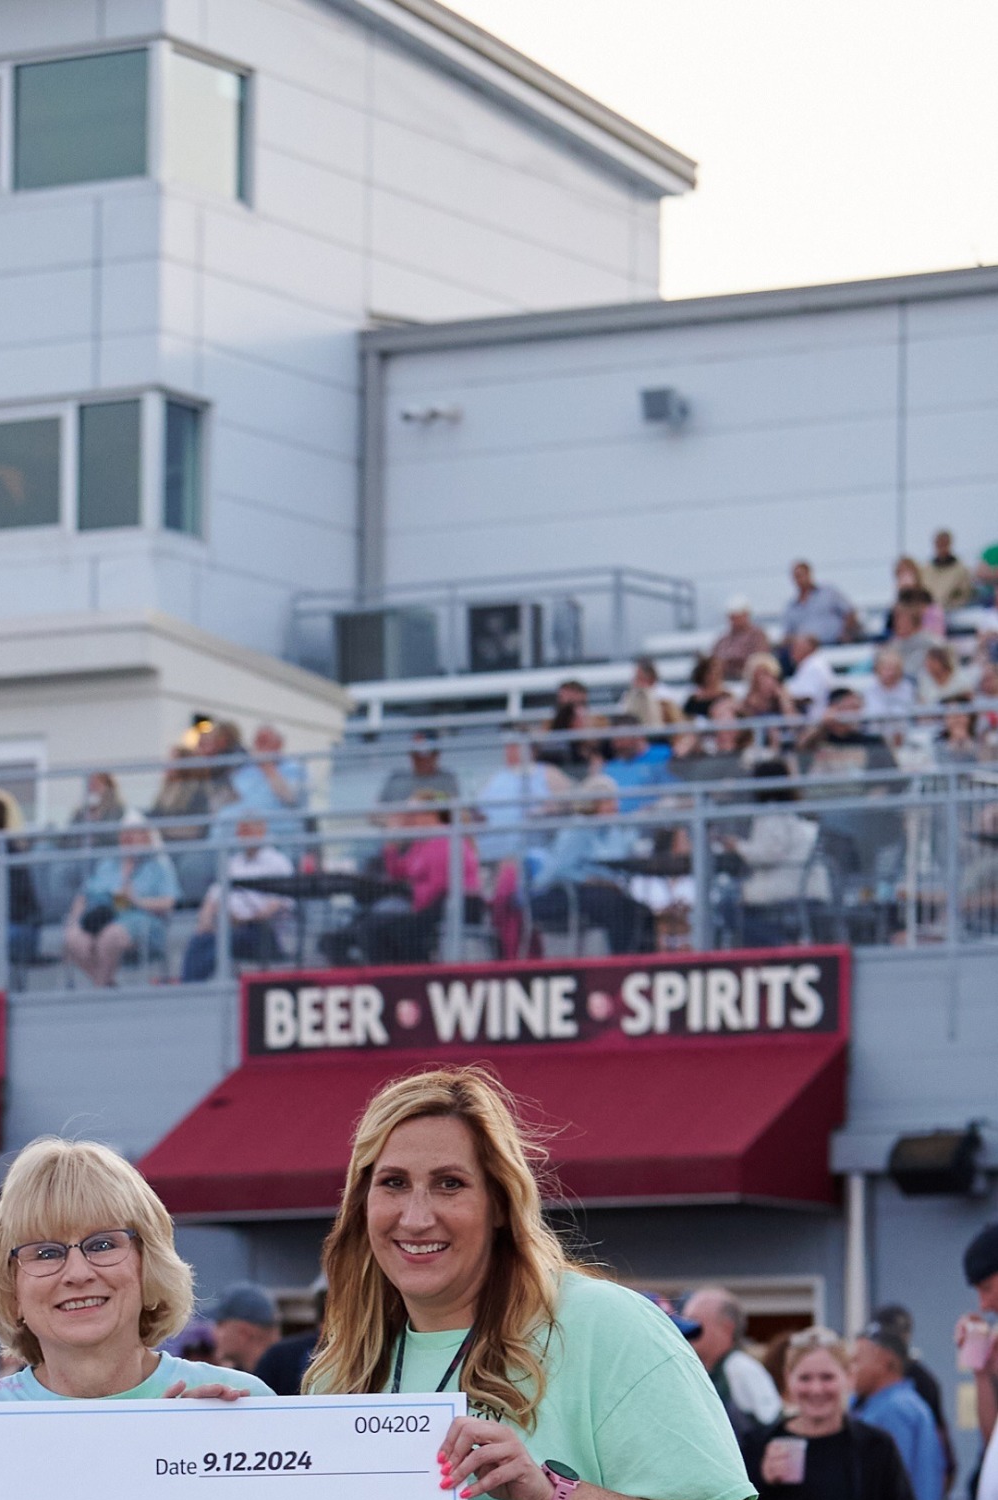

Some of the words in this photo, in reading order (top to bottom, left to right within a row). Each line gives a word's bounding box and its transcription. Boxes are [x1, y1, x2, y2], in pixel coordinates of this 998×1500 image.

[264, 986, 389, 1049] BEER
[428, 977, 577, 1042] WINE
[620, 964, 824, 1035] SPIRITS
[354, 1415, 431, 1434] 004202
[156, 1458, 197, 1476] Date
[202, 1450, 313, 1472] 9.12.2024
